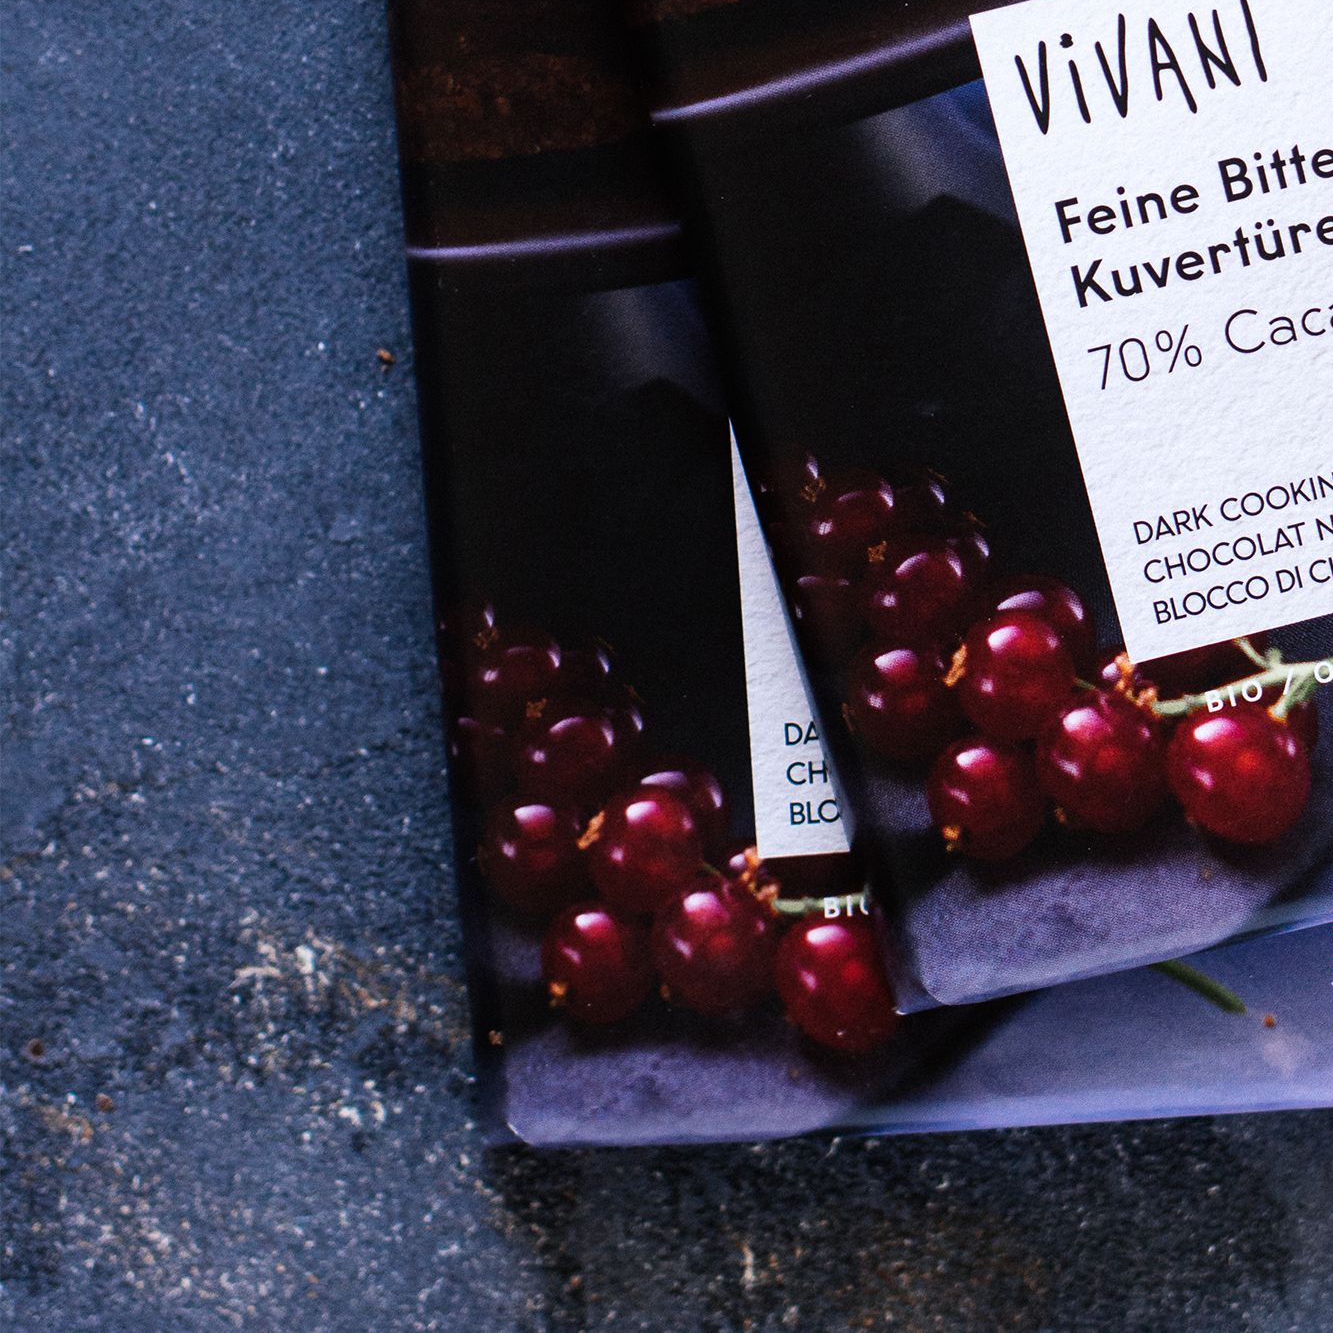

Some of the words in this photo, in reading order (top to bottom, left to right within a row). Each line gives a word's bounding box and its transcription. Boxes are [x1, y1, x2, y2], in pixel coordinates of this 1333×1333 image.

[1055, 185, 1199, 243] Feine
[1088, 325, 1202, 389] 70%
[1134, 504, 1213, 544] DARK
[1143, 523, 1306, 584] CHOCOLAT
[1153, 576, 1269, 624] BLOCCO
[1276, 566, 1303, 593] DI
[1205, 681, 1263, 713] BIO
